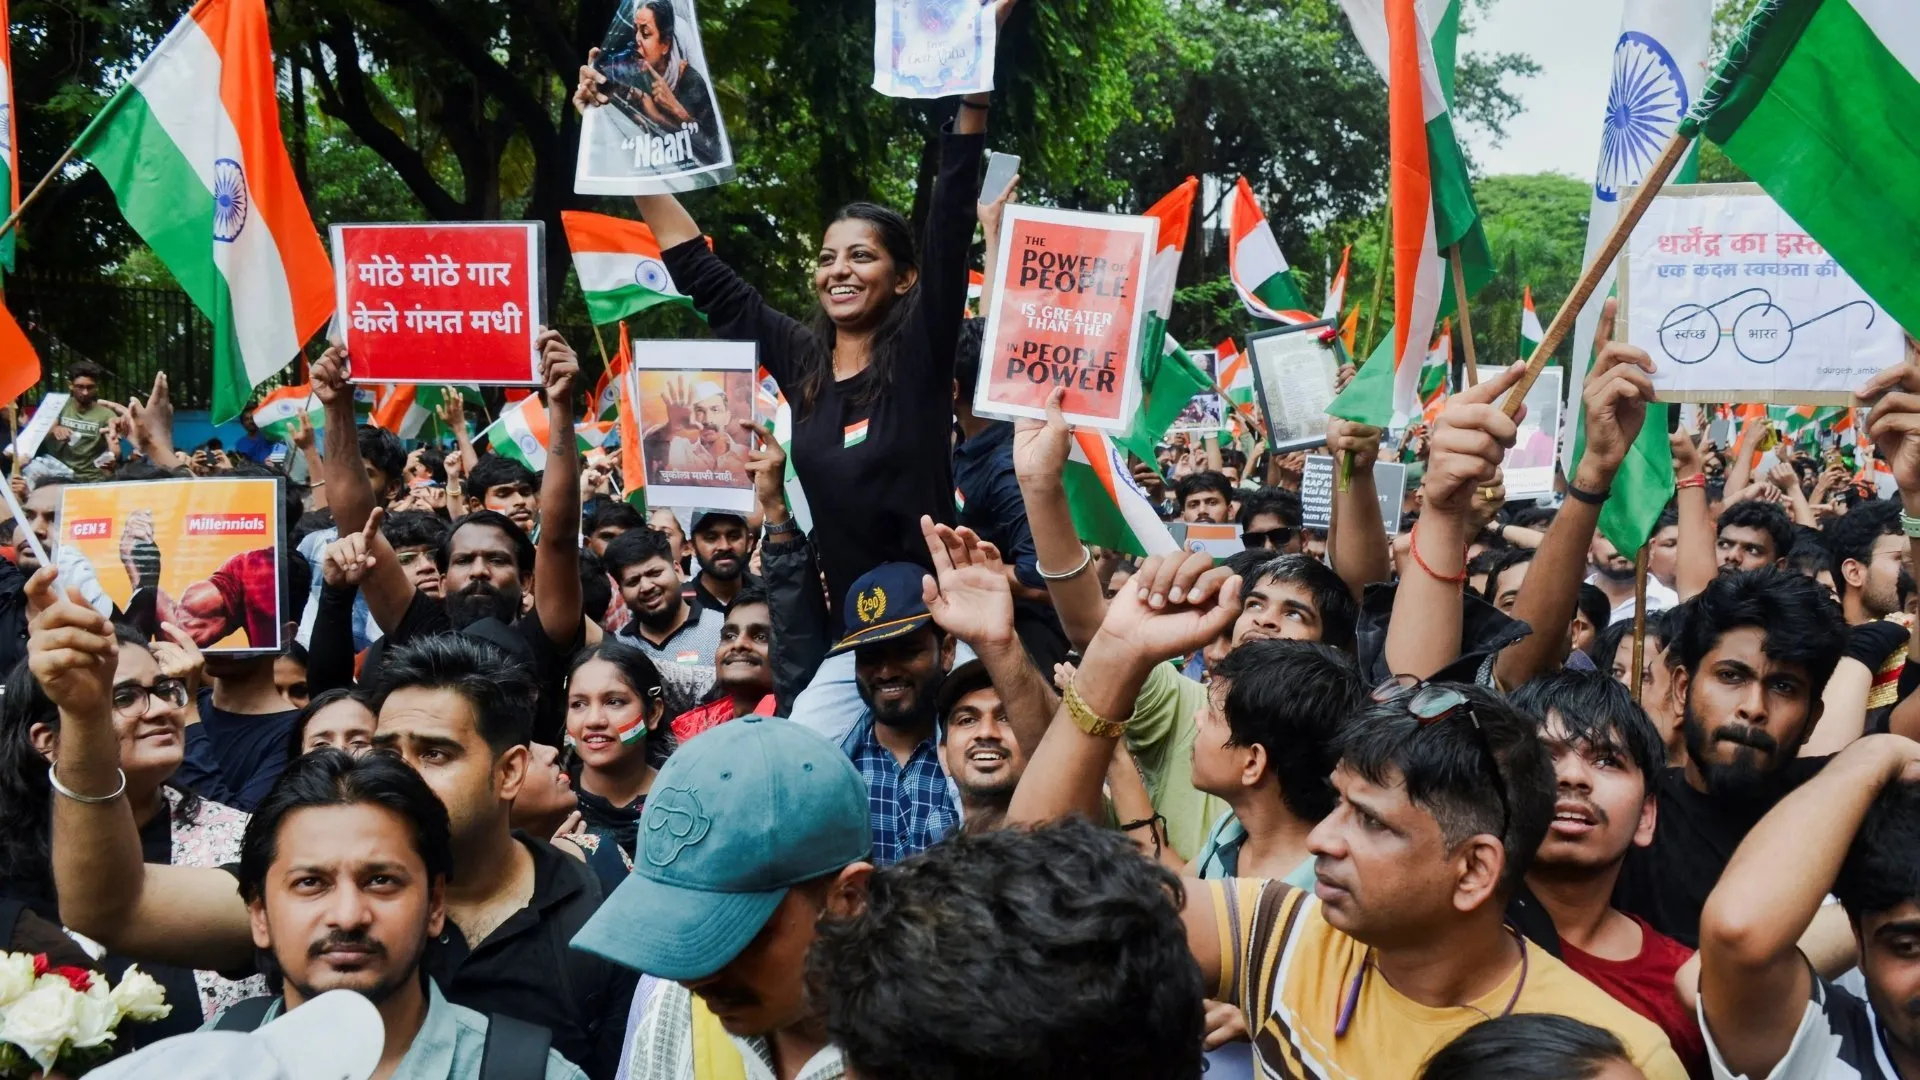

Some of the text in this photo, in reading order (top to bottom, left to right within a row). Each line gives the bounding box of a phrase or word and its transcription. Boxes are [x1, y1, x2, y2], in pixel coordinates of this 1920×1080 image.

[1025, 235, 1046, 247] THE
[1728, 233, 1768, 254] का
[1776, 233, 1824, 258] इस्त
[1022, 249, 1126, 274] POWER OF
[1657, 260, 1838, 278] एक कदम स्वच्छता की
[358, 254, 512, 287] मोठे मोठे गार
[1020, 266, 1128, 298] PEOPLE
[352, 301, 523, 334] केले गंमत मधी
[1021, 303, 1113, 326] IS GREATER
[1026, 315, 1106, 337] THAN THE
[1674, 329, 1707, 339] स्वच्छ
[1748, 329, 1778, 339] भारत
[1006, 340, 1117, 371] IN PEOPLE
[1006, 357, 1116, 393] POWER
[691, 469, 713, 481] माफी
[1304, 479, 1323, 487] AAP
[1305, 471, 1332, 480] Congr
[1303, 504, 1332, 513] Accoun
[73, 522, 107, 536] GEN Z
[189, 517, 265, 531] Millennials
[863, 596, 878, 612] 290
